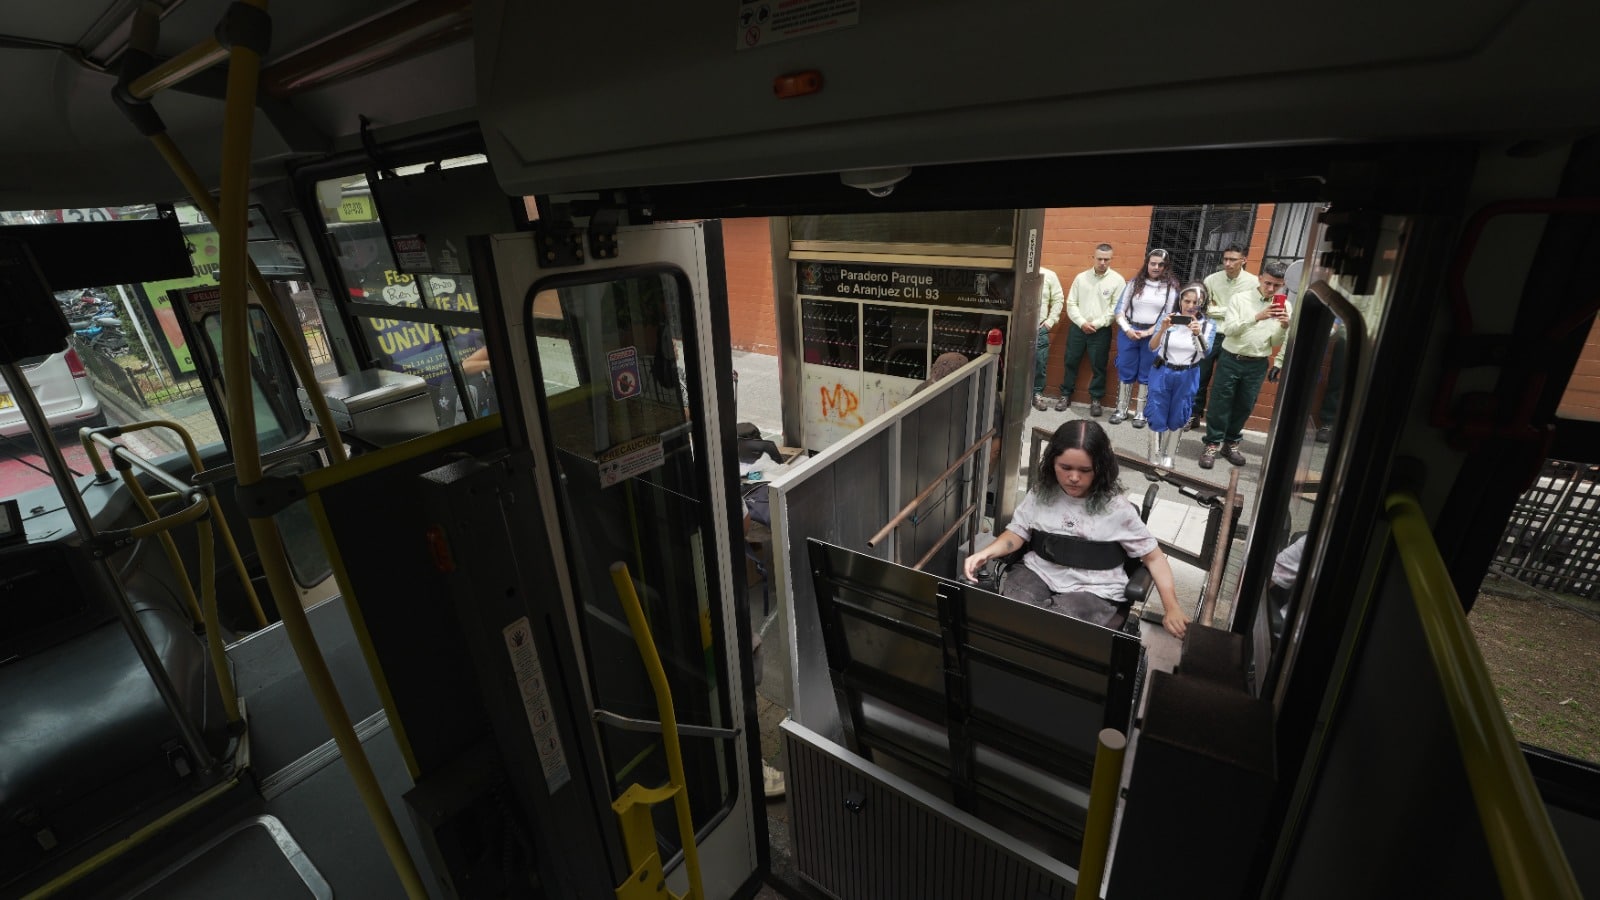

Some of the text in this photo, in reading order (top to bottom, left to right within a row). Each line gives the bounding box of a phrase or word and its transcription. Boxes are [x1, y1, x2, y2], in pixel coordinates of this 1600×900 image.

[840, 269, 933, 287] Paradero Parque
[193, 292, 220, 305] PELIG
[836, 282, 850, 293] de
[852, 283, 900, 299] Aranjuez
[925, 288, 940, 300] 93
[457, 292, 479, 312] AL
[377, 323, 483, 355] UNIVE
